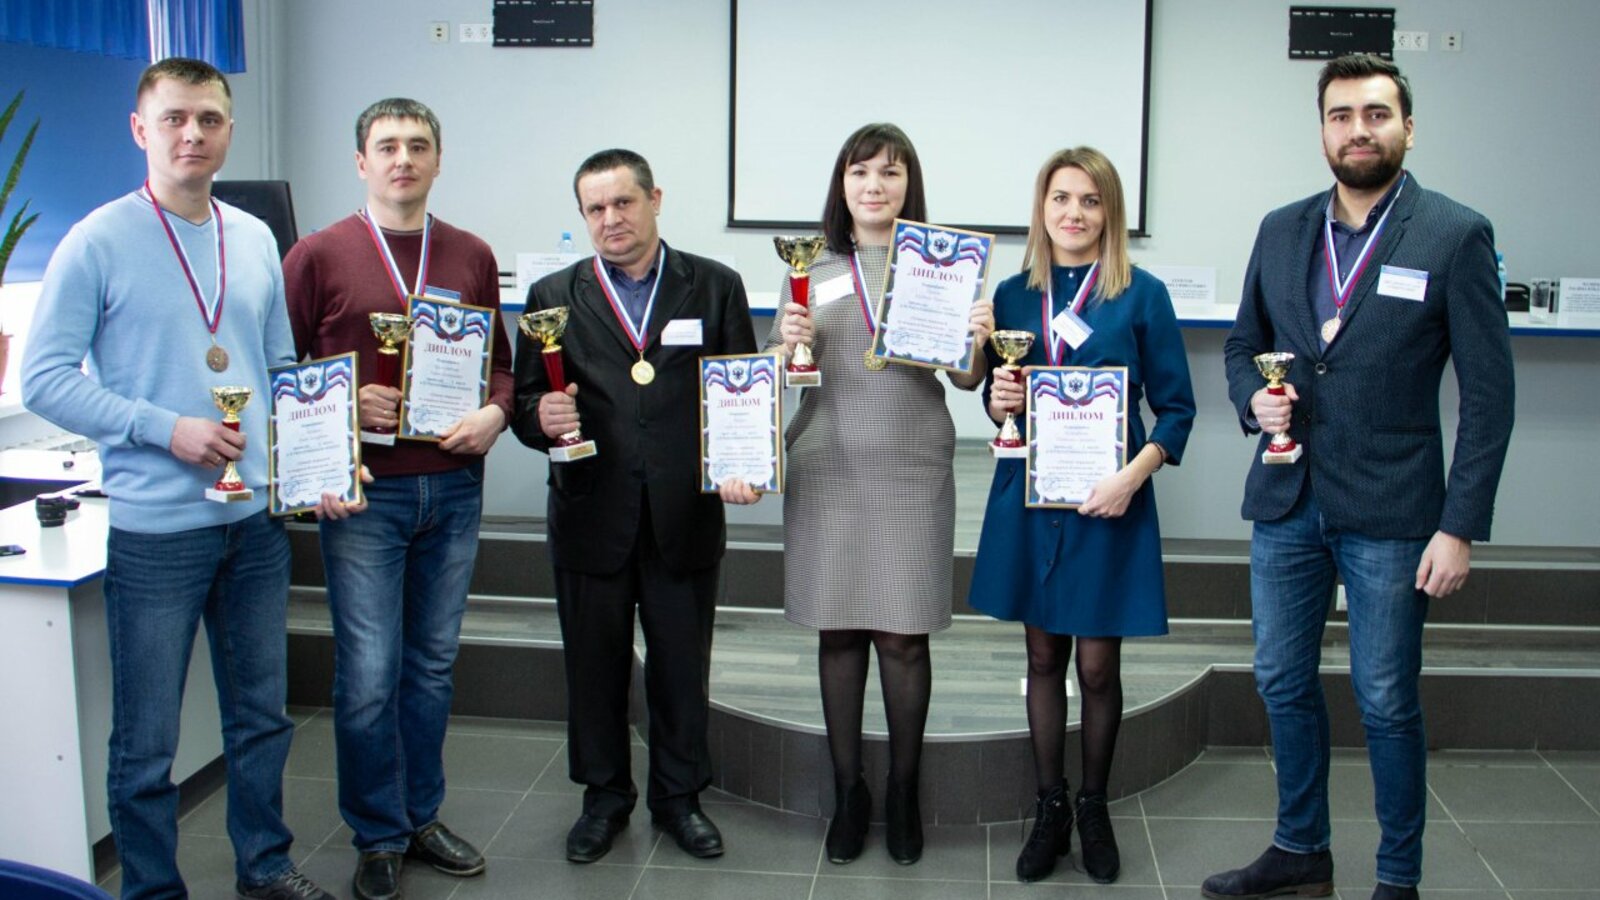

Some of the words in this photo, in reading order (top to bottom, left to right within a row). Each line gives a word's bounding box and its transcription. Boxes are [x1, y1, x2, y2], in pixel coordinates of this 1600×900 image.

[907, 266, 964, 284] ДИПЛОМ
[423, 342, 472, 358] ДИПЛОМ
[717, 397, 761, 409] ДИПЛОМ
[287, 403, 337, 422] ДИПЛОМ
[1048, 411, 1104, 422] ДИПЛОМ
